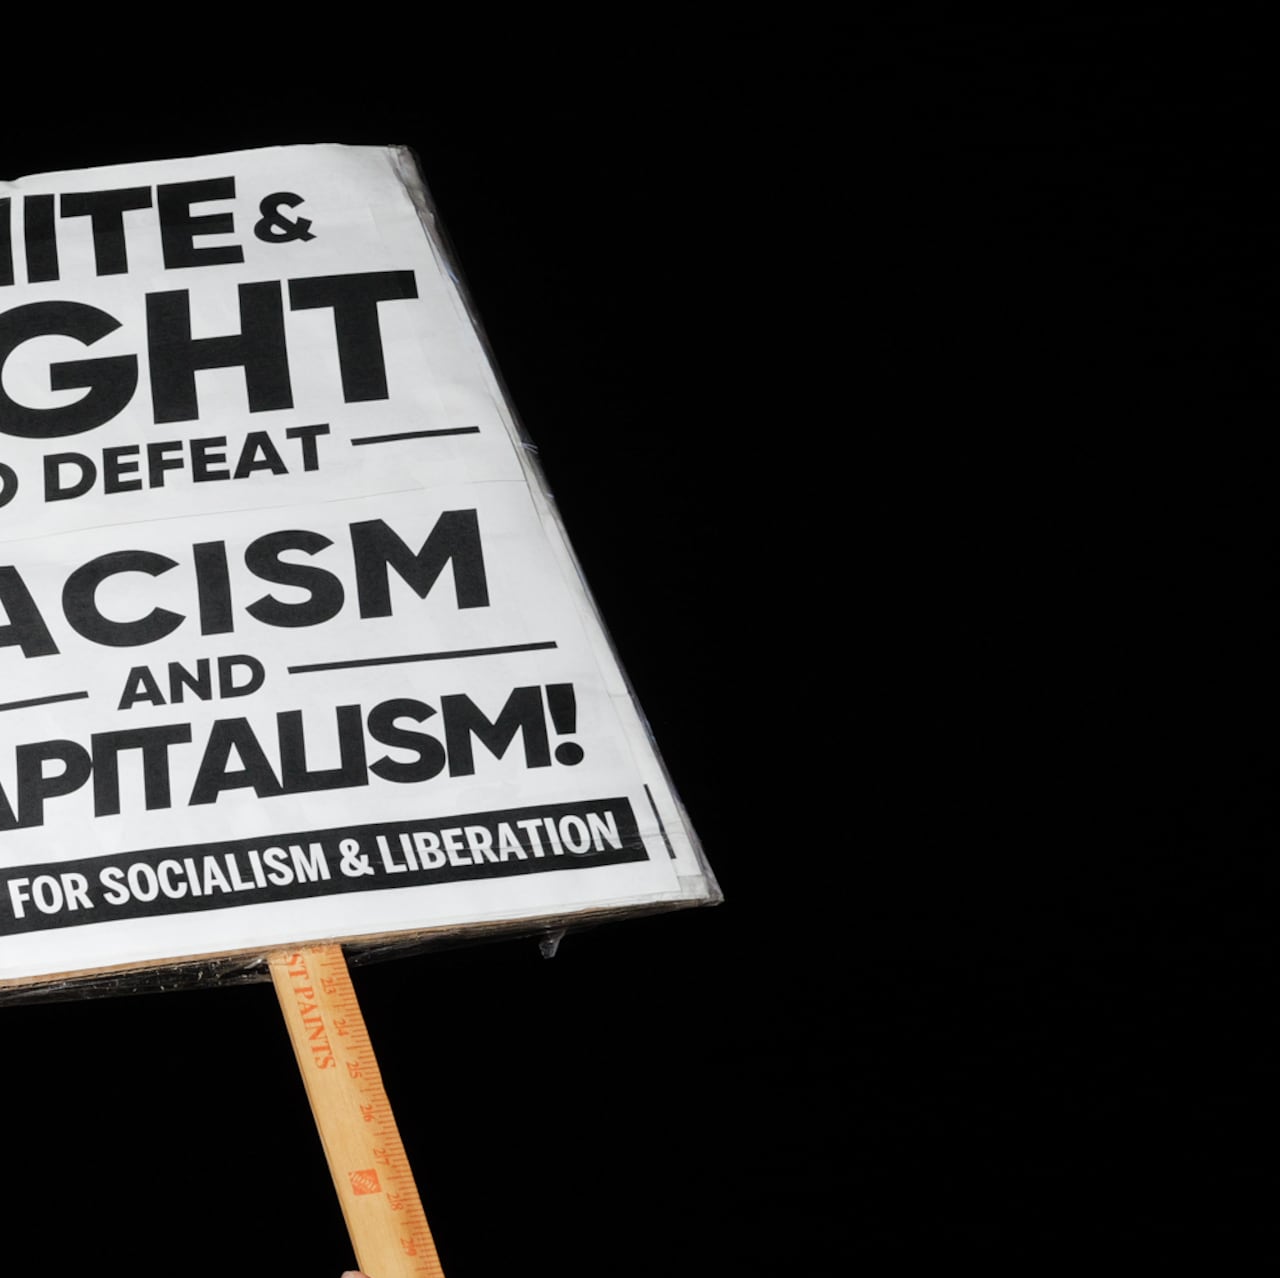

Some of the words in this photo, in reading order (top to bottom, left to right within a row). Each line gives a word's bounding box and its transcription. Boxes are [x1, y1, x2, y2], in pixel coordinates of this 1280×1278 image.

[254, 192, 316, 243] &
[44, 424, 330, 502] DEFEAT
[118, 655, 265, 710] AND
[7, 873, 94, 918] FOR
[100, 843, 330, 904] SOCIALISM
[339, 839, 374, 876] &
[378, 812, 620, 873] LIBERATION
[294, 986, 336, 1070] PAINTS
[333, 1018, 349, 1036] 24
[373, 1147, 390, 1167] 27
